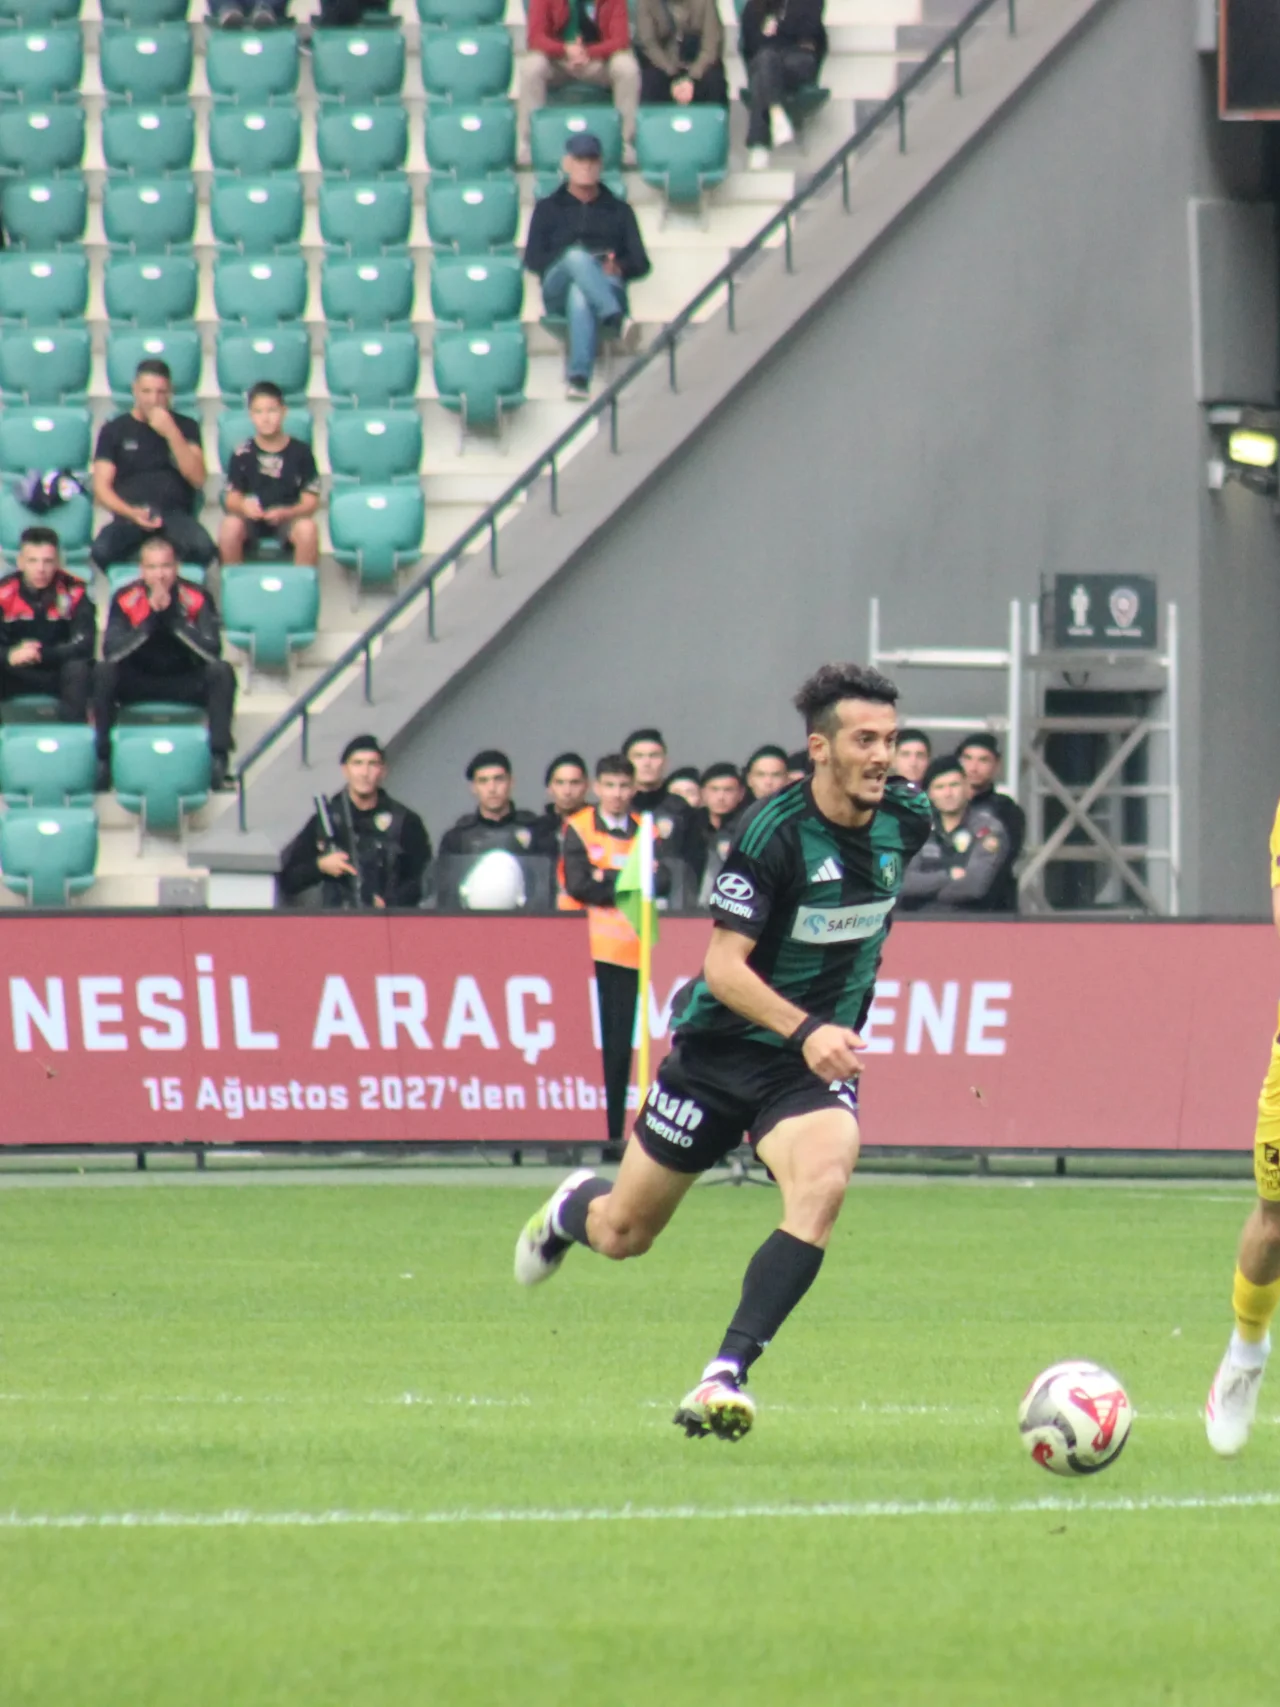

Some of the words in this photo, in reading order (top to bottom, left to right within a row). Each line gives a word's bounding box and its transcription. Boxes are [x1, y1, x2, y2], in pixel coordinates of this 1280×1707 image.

[826, 912, 888, 933] SAFİPOR
[9, 954, 279, 1051] NESİL
[312, 975, 557, 1065] ARAÇ
[143, 1077, 184, 1111] 15
[196, 1077, 349, 1120] Ağustos
[359, 1076, 526, 1110] 2027'den
